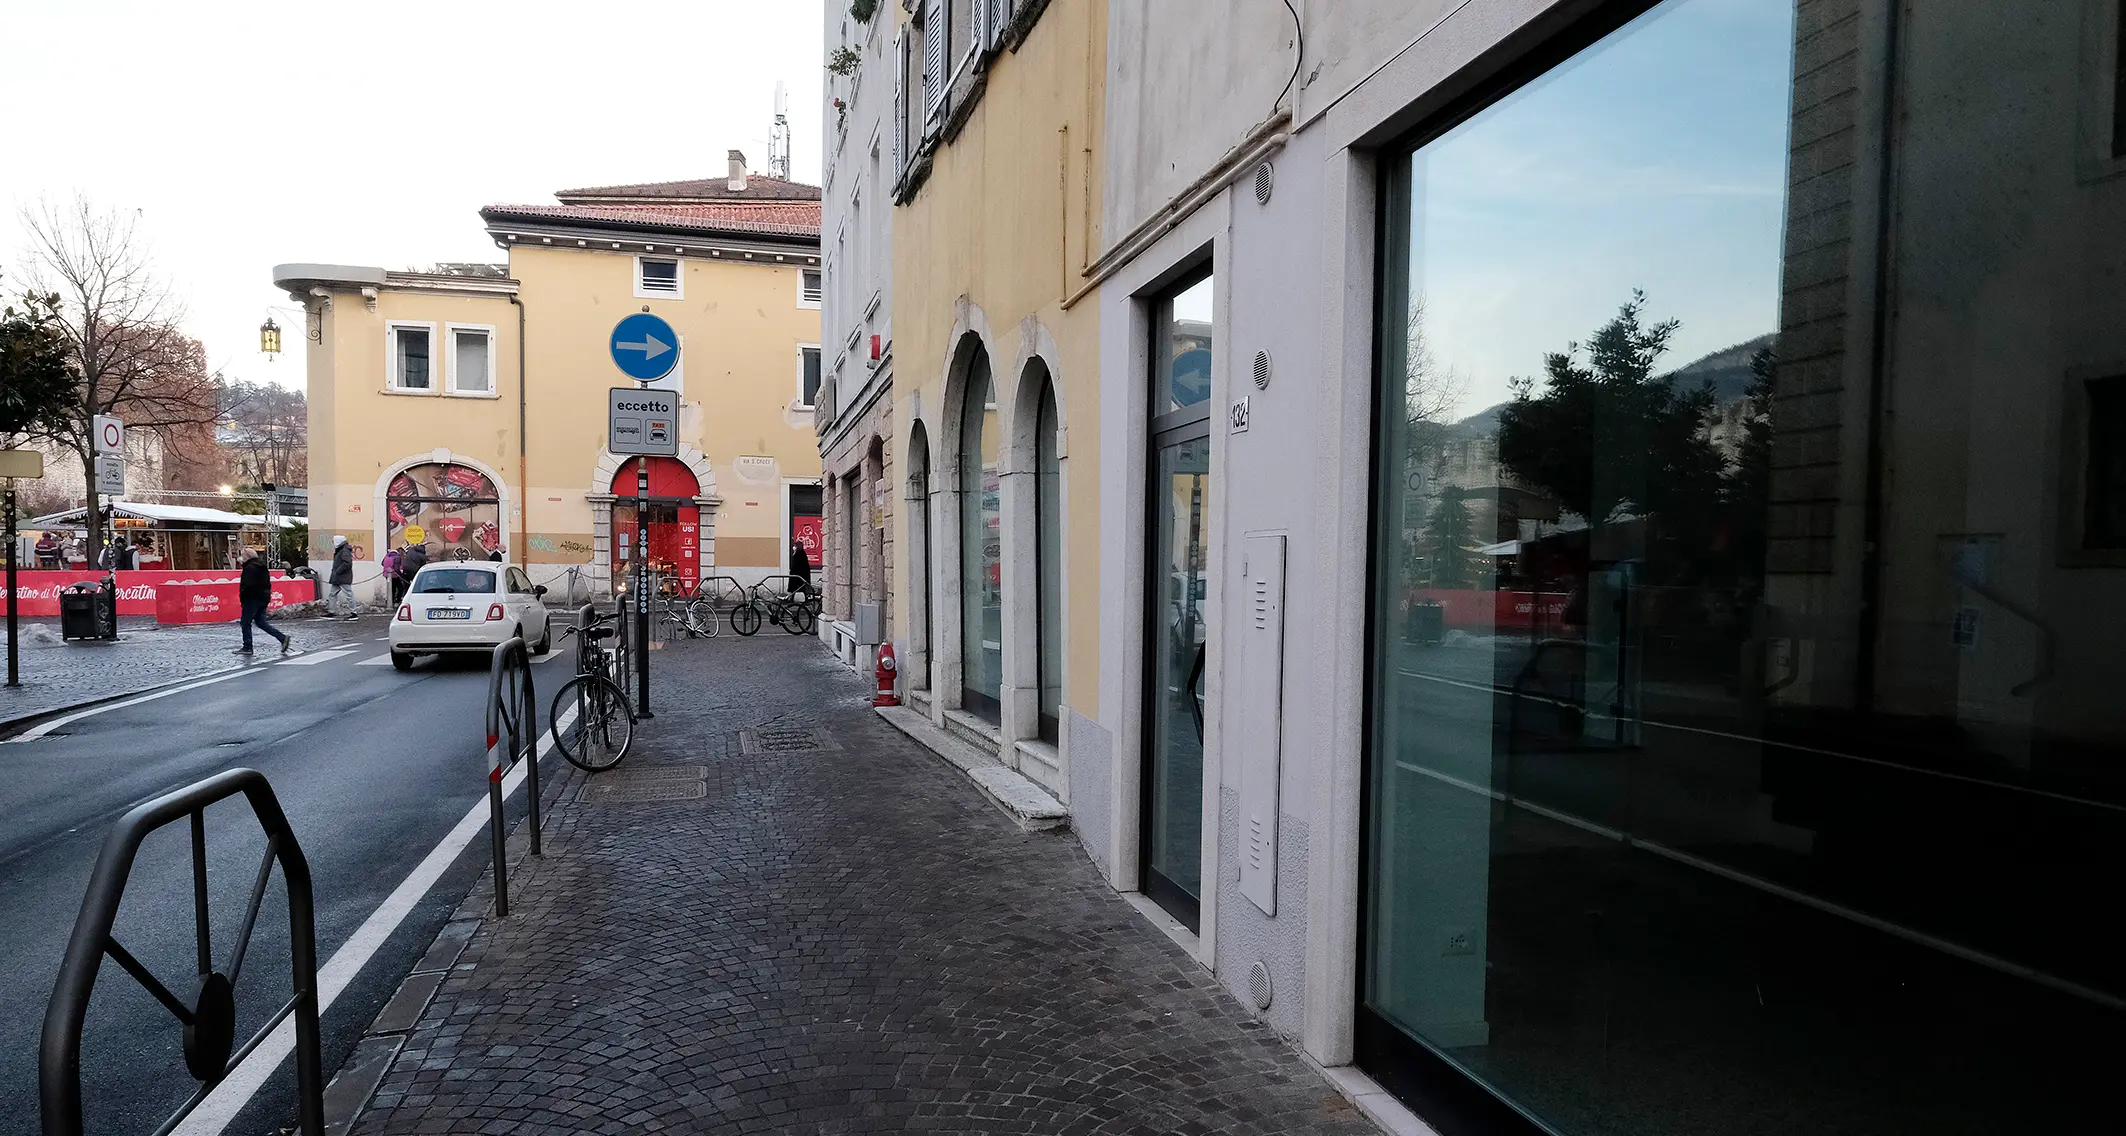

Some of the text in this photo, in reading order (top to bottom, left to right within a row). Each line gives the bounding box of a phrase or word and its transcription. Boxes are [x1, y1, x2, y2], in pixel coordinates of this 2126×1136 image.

[617, 401, 669, 413] eccetto
[1232, 402, 1246, 428] 132
[40, 587, 51, 599] di
